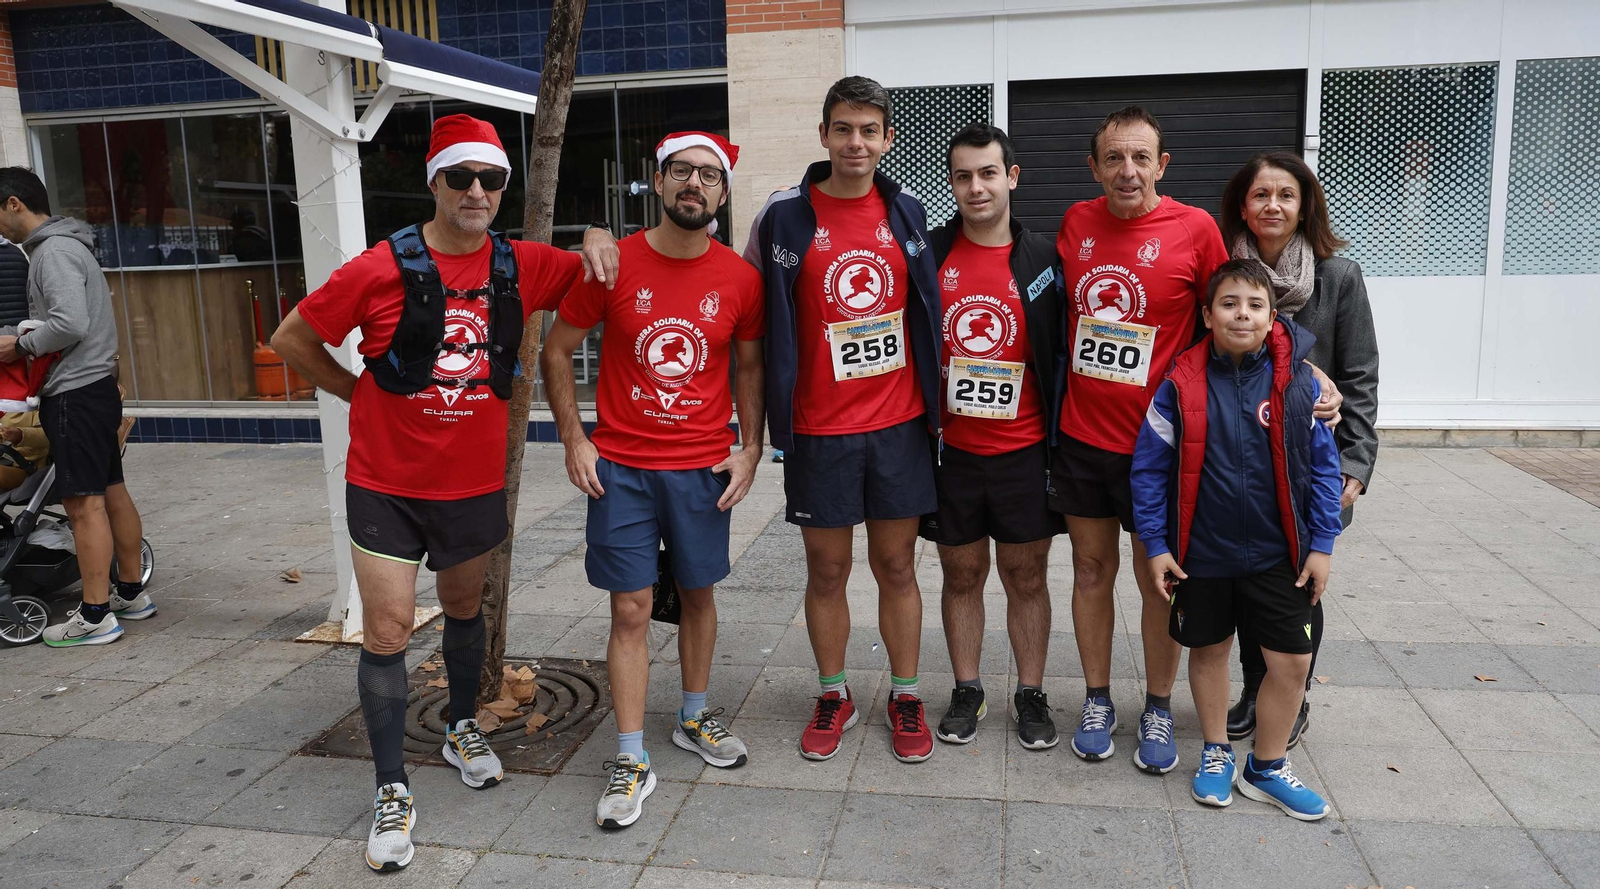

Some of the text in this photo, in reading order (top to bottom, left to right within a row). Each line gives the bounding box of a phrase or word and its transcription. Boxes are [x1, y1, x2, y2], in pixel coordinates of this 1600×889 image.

[824, 261, 839, 294] CARRERA
[838, 250, 875, 263] SOLIDARIA
[876, 256, 886, 265] DE
[884, 264, 894, 297] NAVIDAD
[961, 295, 1001, 307] SOLIDARIA
[1075, 272, 1092, 303] CARRERA
[1092, 264, 1130, 276] SOLIDARIA
[1129, 273, 1140, 284] DE
[1136, 284, 1147, 318] NAVIDAD
[445, 309, 486, 327] LIDARIA DE
[942, 301, 961, 332] CARRERA
[1001, 304, 1012, 314] DE
[635, 325, 654, 355] CARRERA
[653, 317, 694, 330] SOLIDARIA
[693, 328, 704, 338] DE
[699, 338, 708, 371] NAVIDAD
[1006, 314, 1018, 347] NAVIDAD
[841, 334, 898, 365] 258
[1079, 338, 1140, 369] 260
[955, 379, 1014, 405] 259
[423, 408, 473, 416] CUPRA
[644, 409, 688, 420] CUPRA
